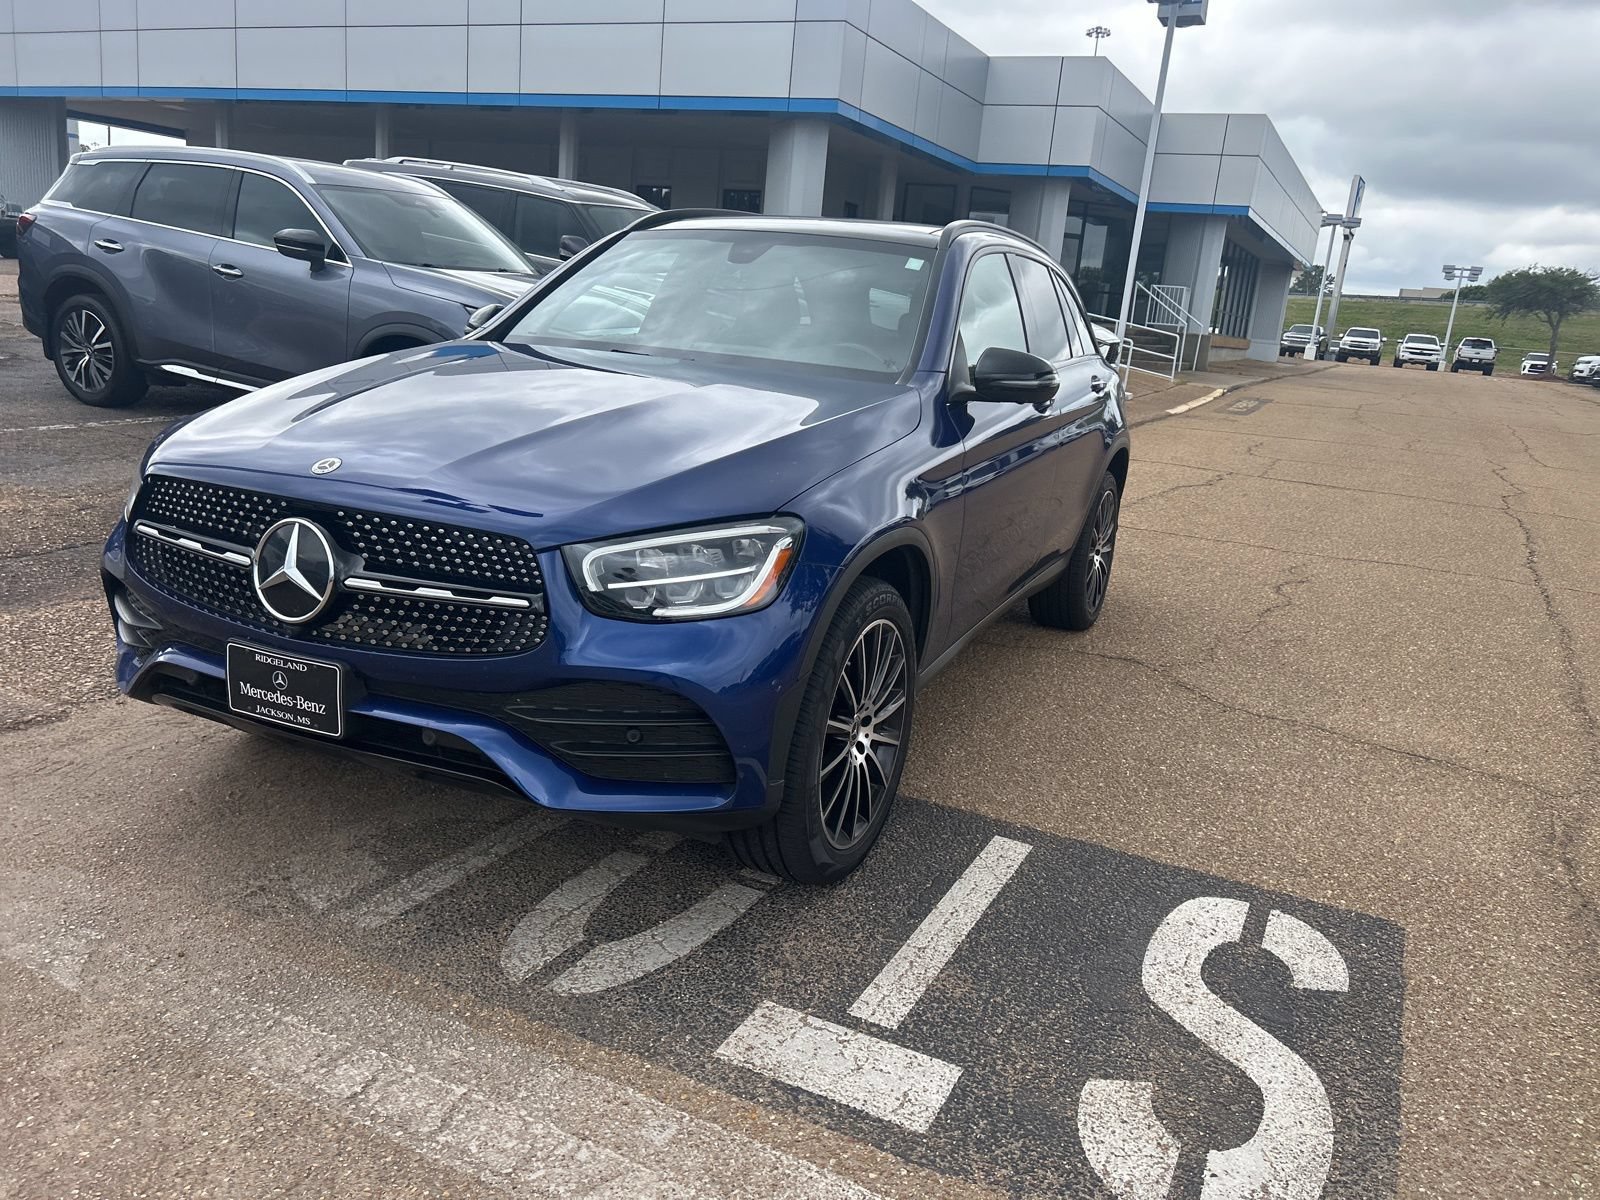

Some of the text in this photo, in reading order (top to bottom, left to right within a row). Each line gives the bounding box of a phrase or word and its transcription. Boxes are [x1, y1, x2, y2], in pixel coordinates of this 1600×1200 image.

[865, 593, 907, 611] SCORP
[255, 654, 307, 671] RIDGELAND
[239, 681, 326, 715] Mercedes-Benz
[297, 715, 311, 725] MS
